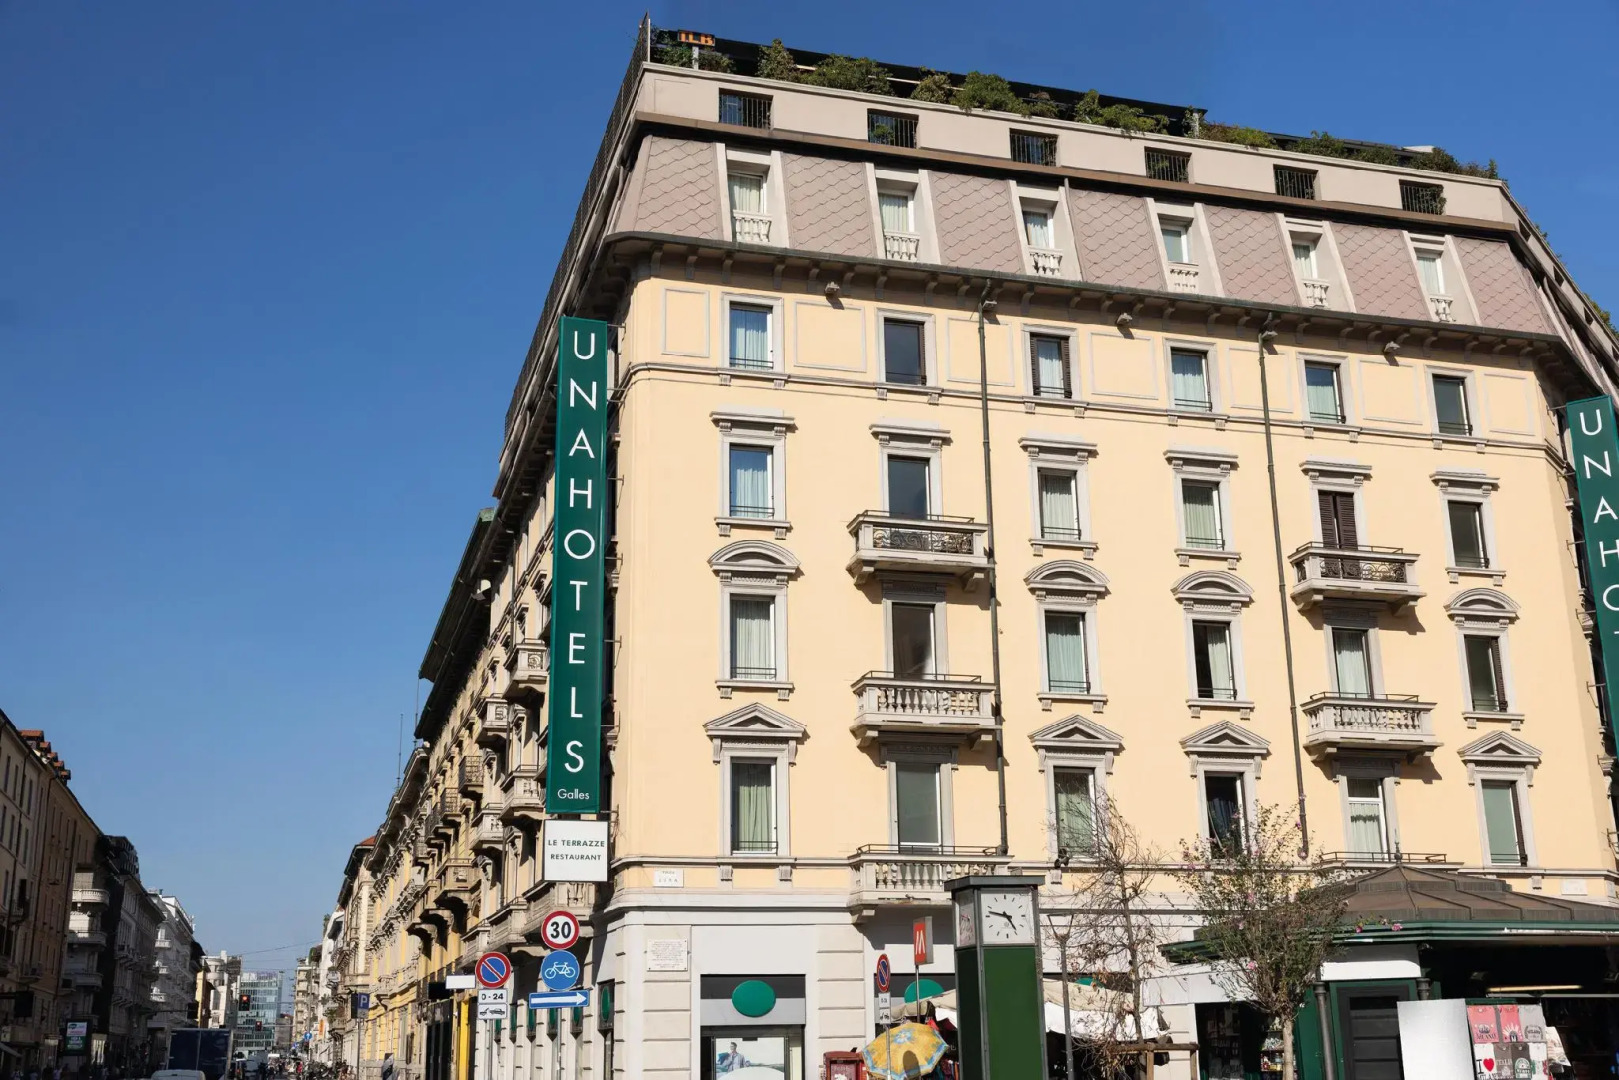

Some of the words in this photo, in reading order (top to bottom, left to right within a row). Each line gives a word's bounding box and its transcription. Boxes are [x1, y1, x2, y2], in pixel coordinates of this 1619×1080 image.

[564, 331, 597, 773] UNAHOTELS
[557, 788, 590, 800] Galles
[561, 839, 605, 847] TERRAZZE
[550, 921, 572, 939] 30
[360, 996, 368, 1007] P
[1476, 1059, 1483, 1074] I
